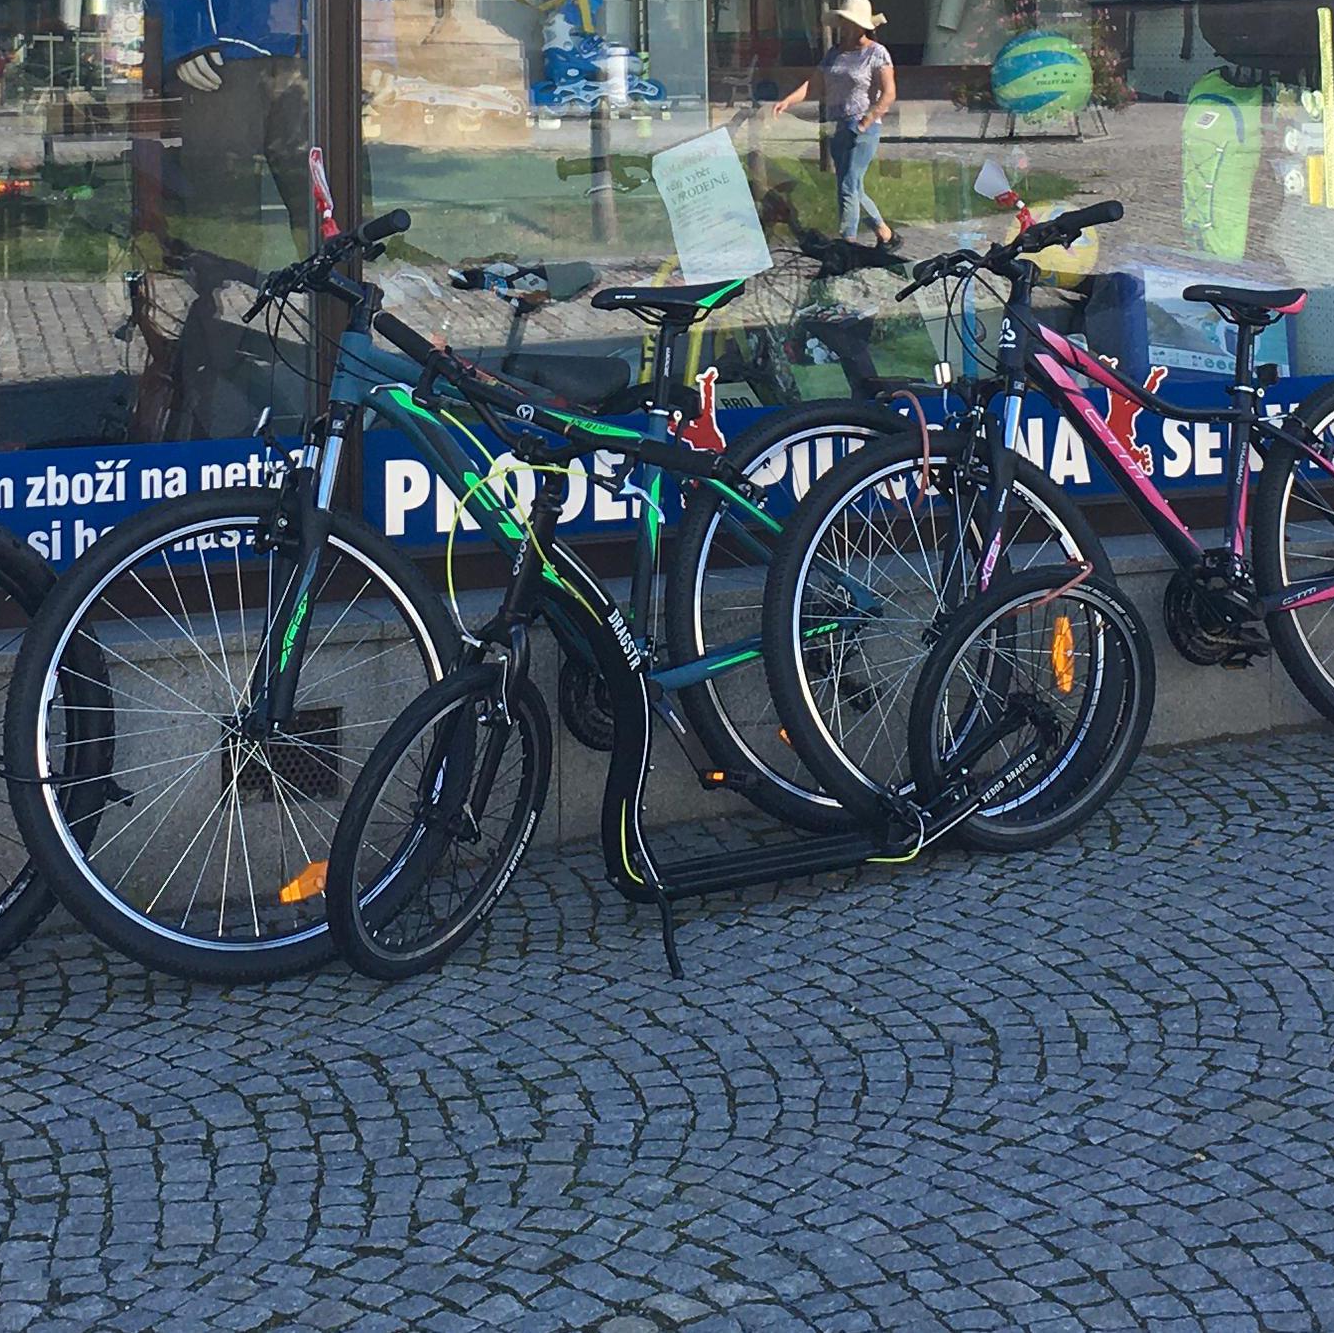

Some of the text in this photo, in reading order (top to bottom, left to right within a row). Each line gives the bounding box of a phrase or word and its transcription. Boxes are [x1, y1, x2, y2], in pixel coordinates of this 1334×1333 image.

[26, 459, 132, 509] zboží
[141, 465, 188, 500] na
[607, 607, 642, 672] DRAGSTR
[1004, 753, 1038, 783] DRAGSTR
